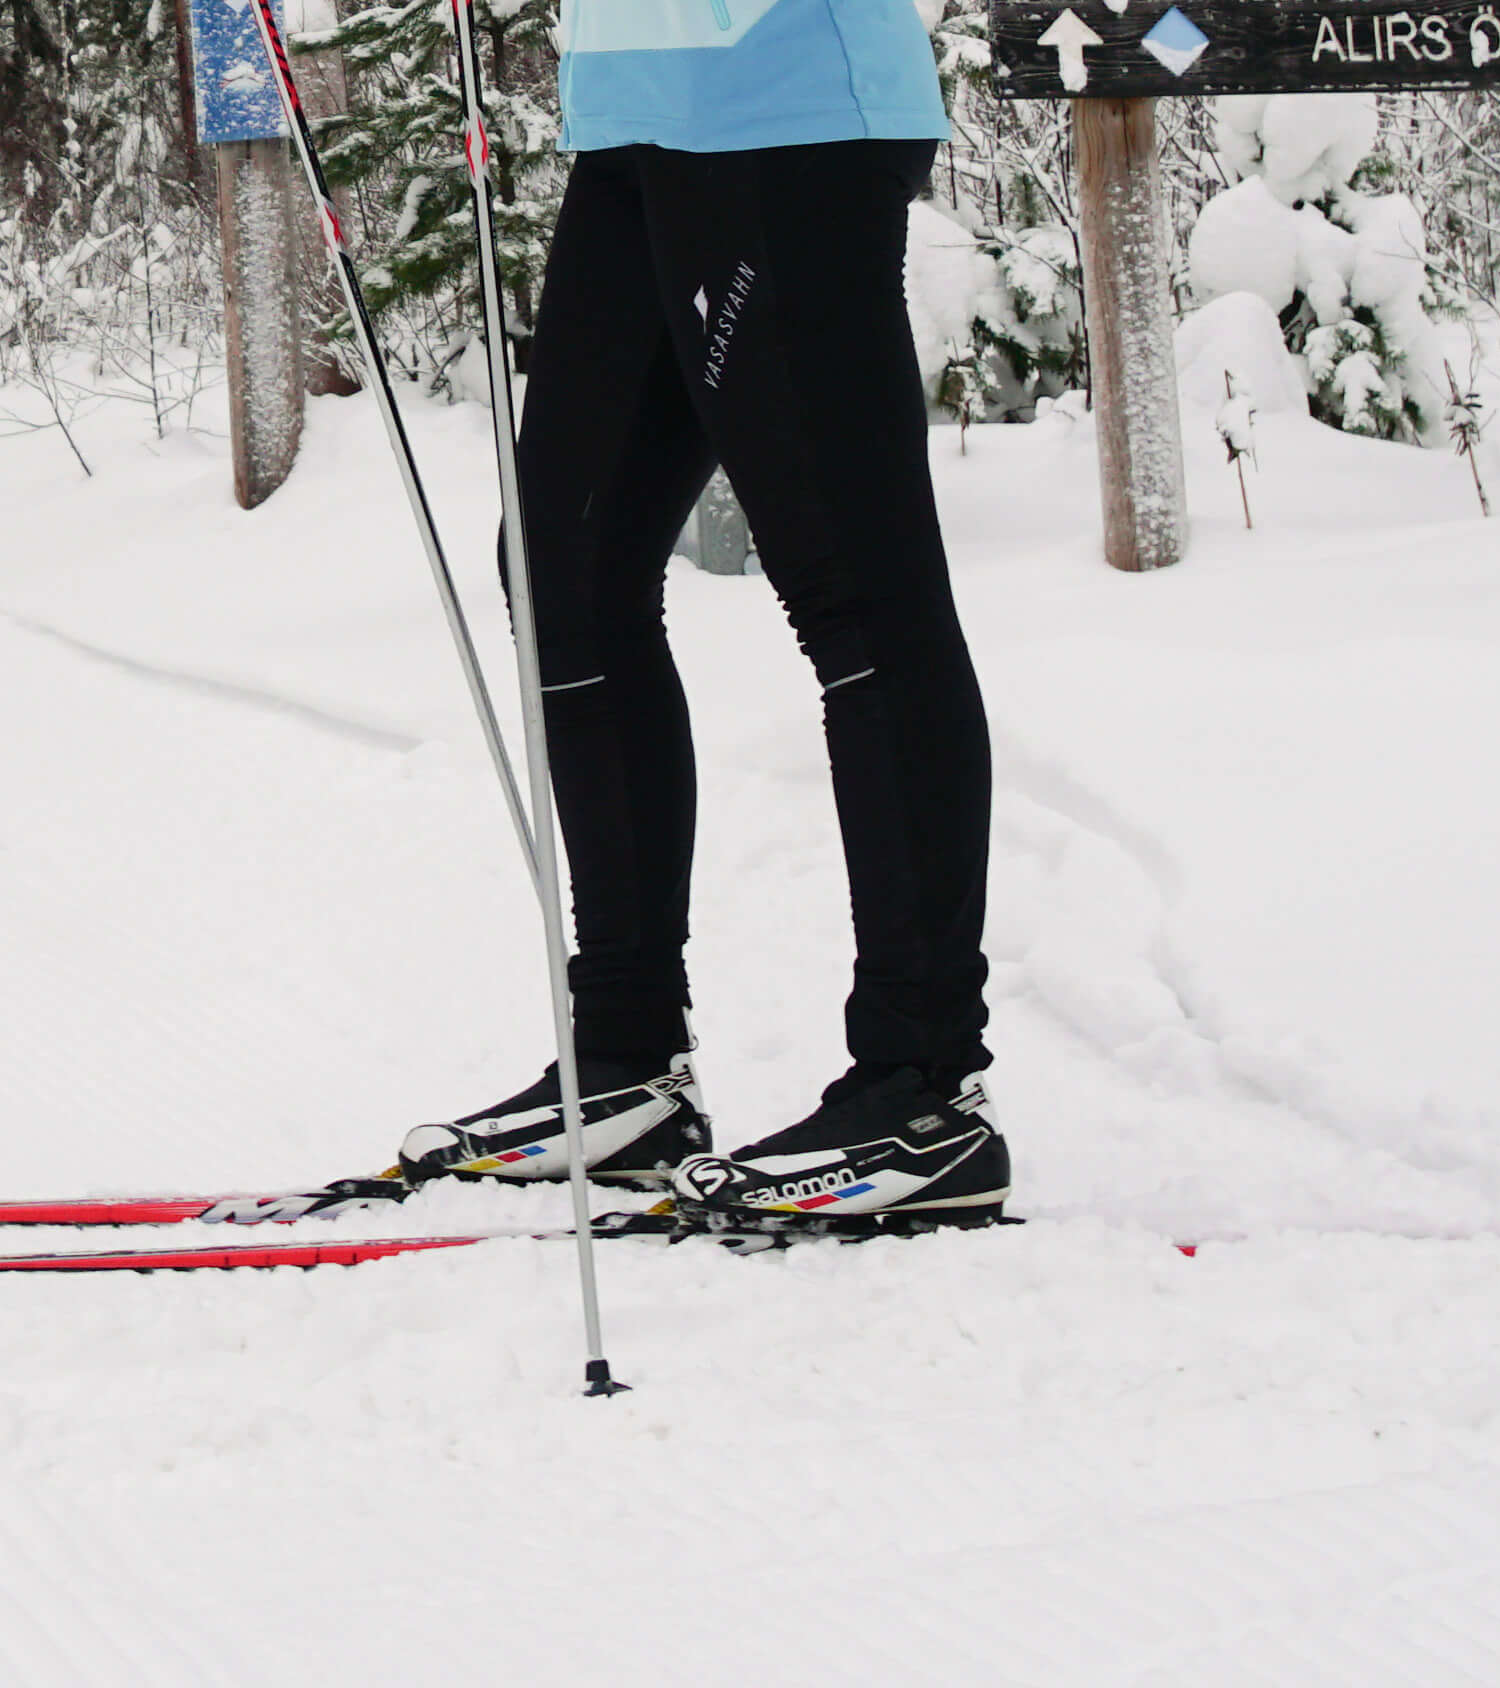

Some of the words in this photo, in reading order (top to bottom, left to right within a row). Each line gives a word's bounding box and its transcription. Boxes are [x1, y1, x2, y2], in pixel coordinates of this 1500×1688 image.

[1312, 12, 1453, 62] ALIRS
[704, 261, 756, 389] VASASVAHN
[742, 1168, 856, 1205] salomon
